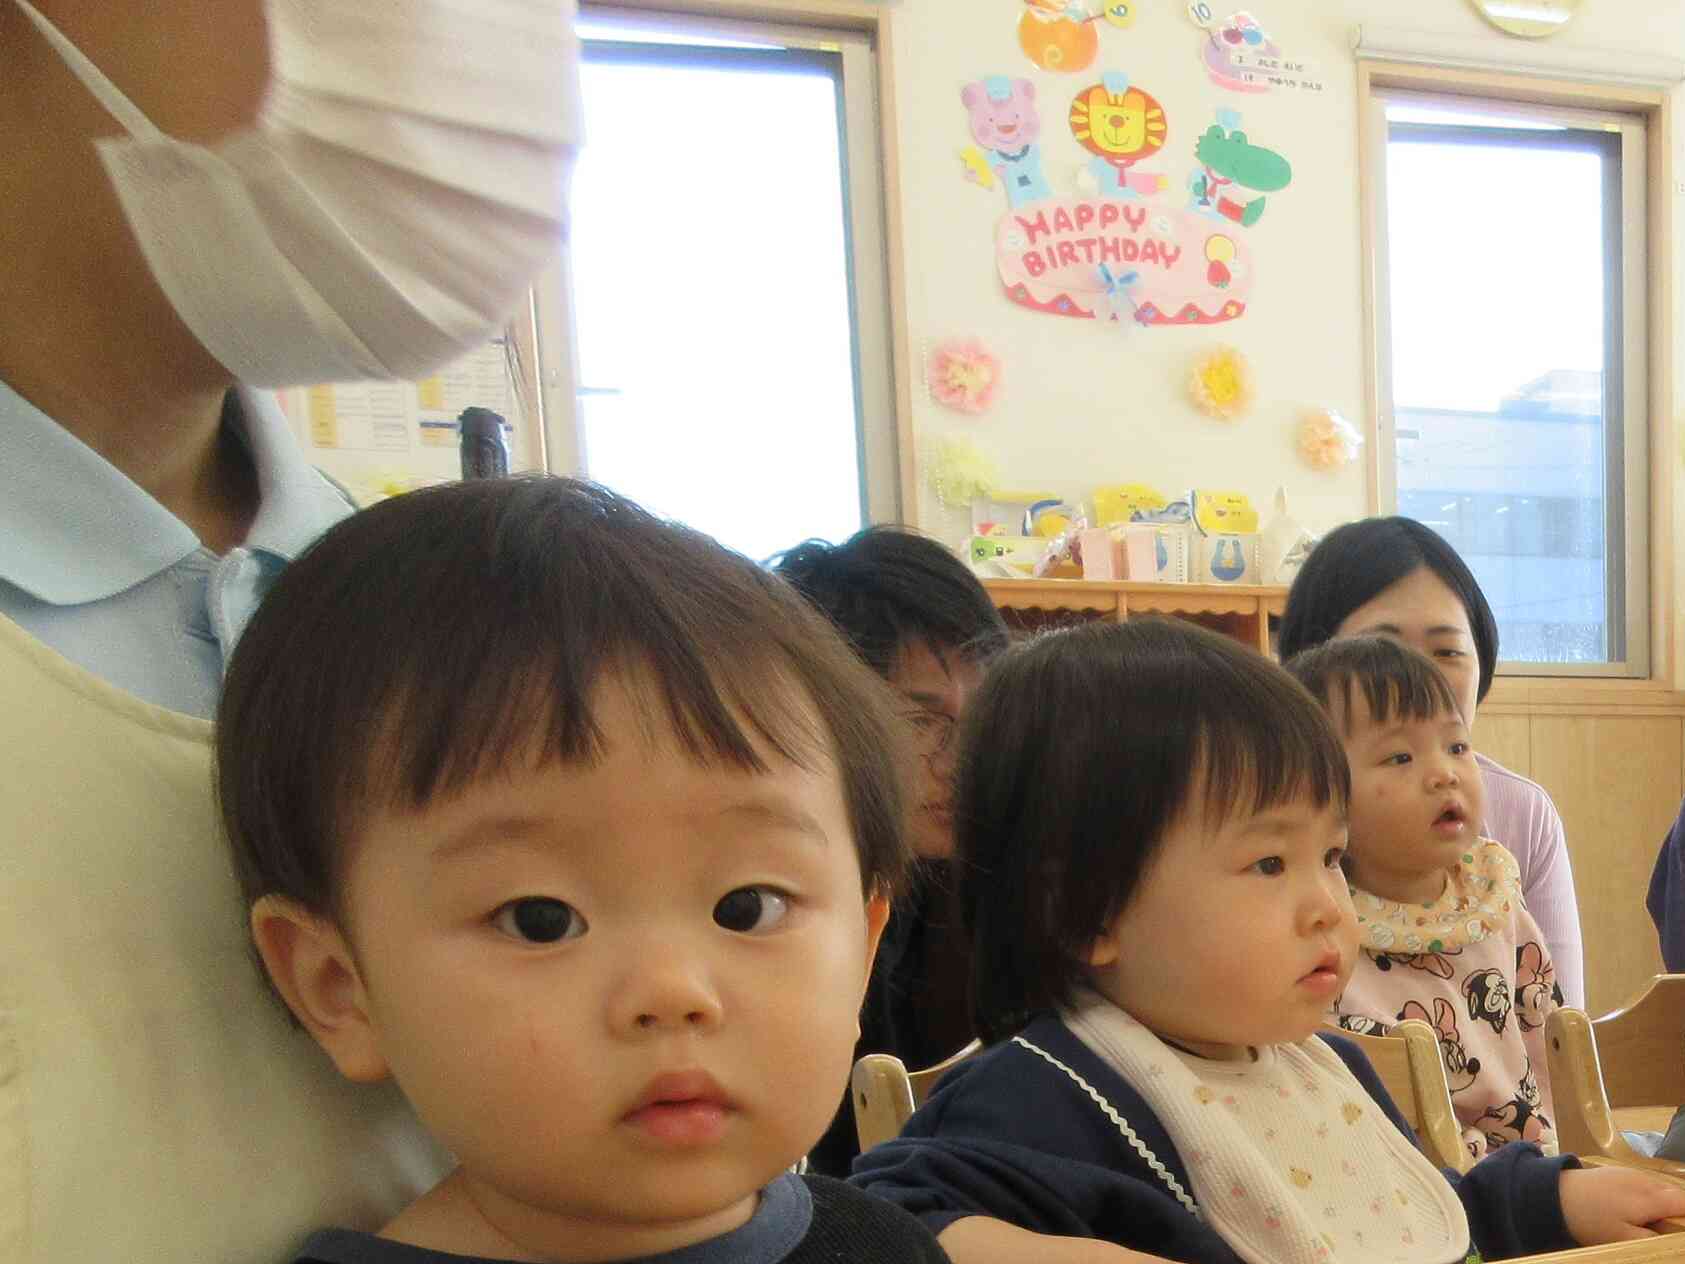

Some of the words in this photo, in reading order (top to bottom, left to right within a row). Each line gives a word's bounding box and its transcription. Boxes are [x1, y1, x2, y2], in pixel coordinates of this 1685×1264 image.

[1191, 2, 1212, 25] 10
[1014, 203, 1147, 245] HAPPY
[1022, 236, 1182, 278] BIRTHDAY
